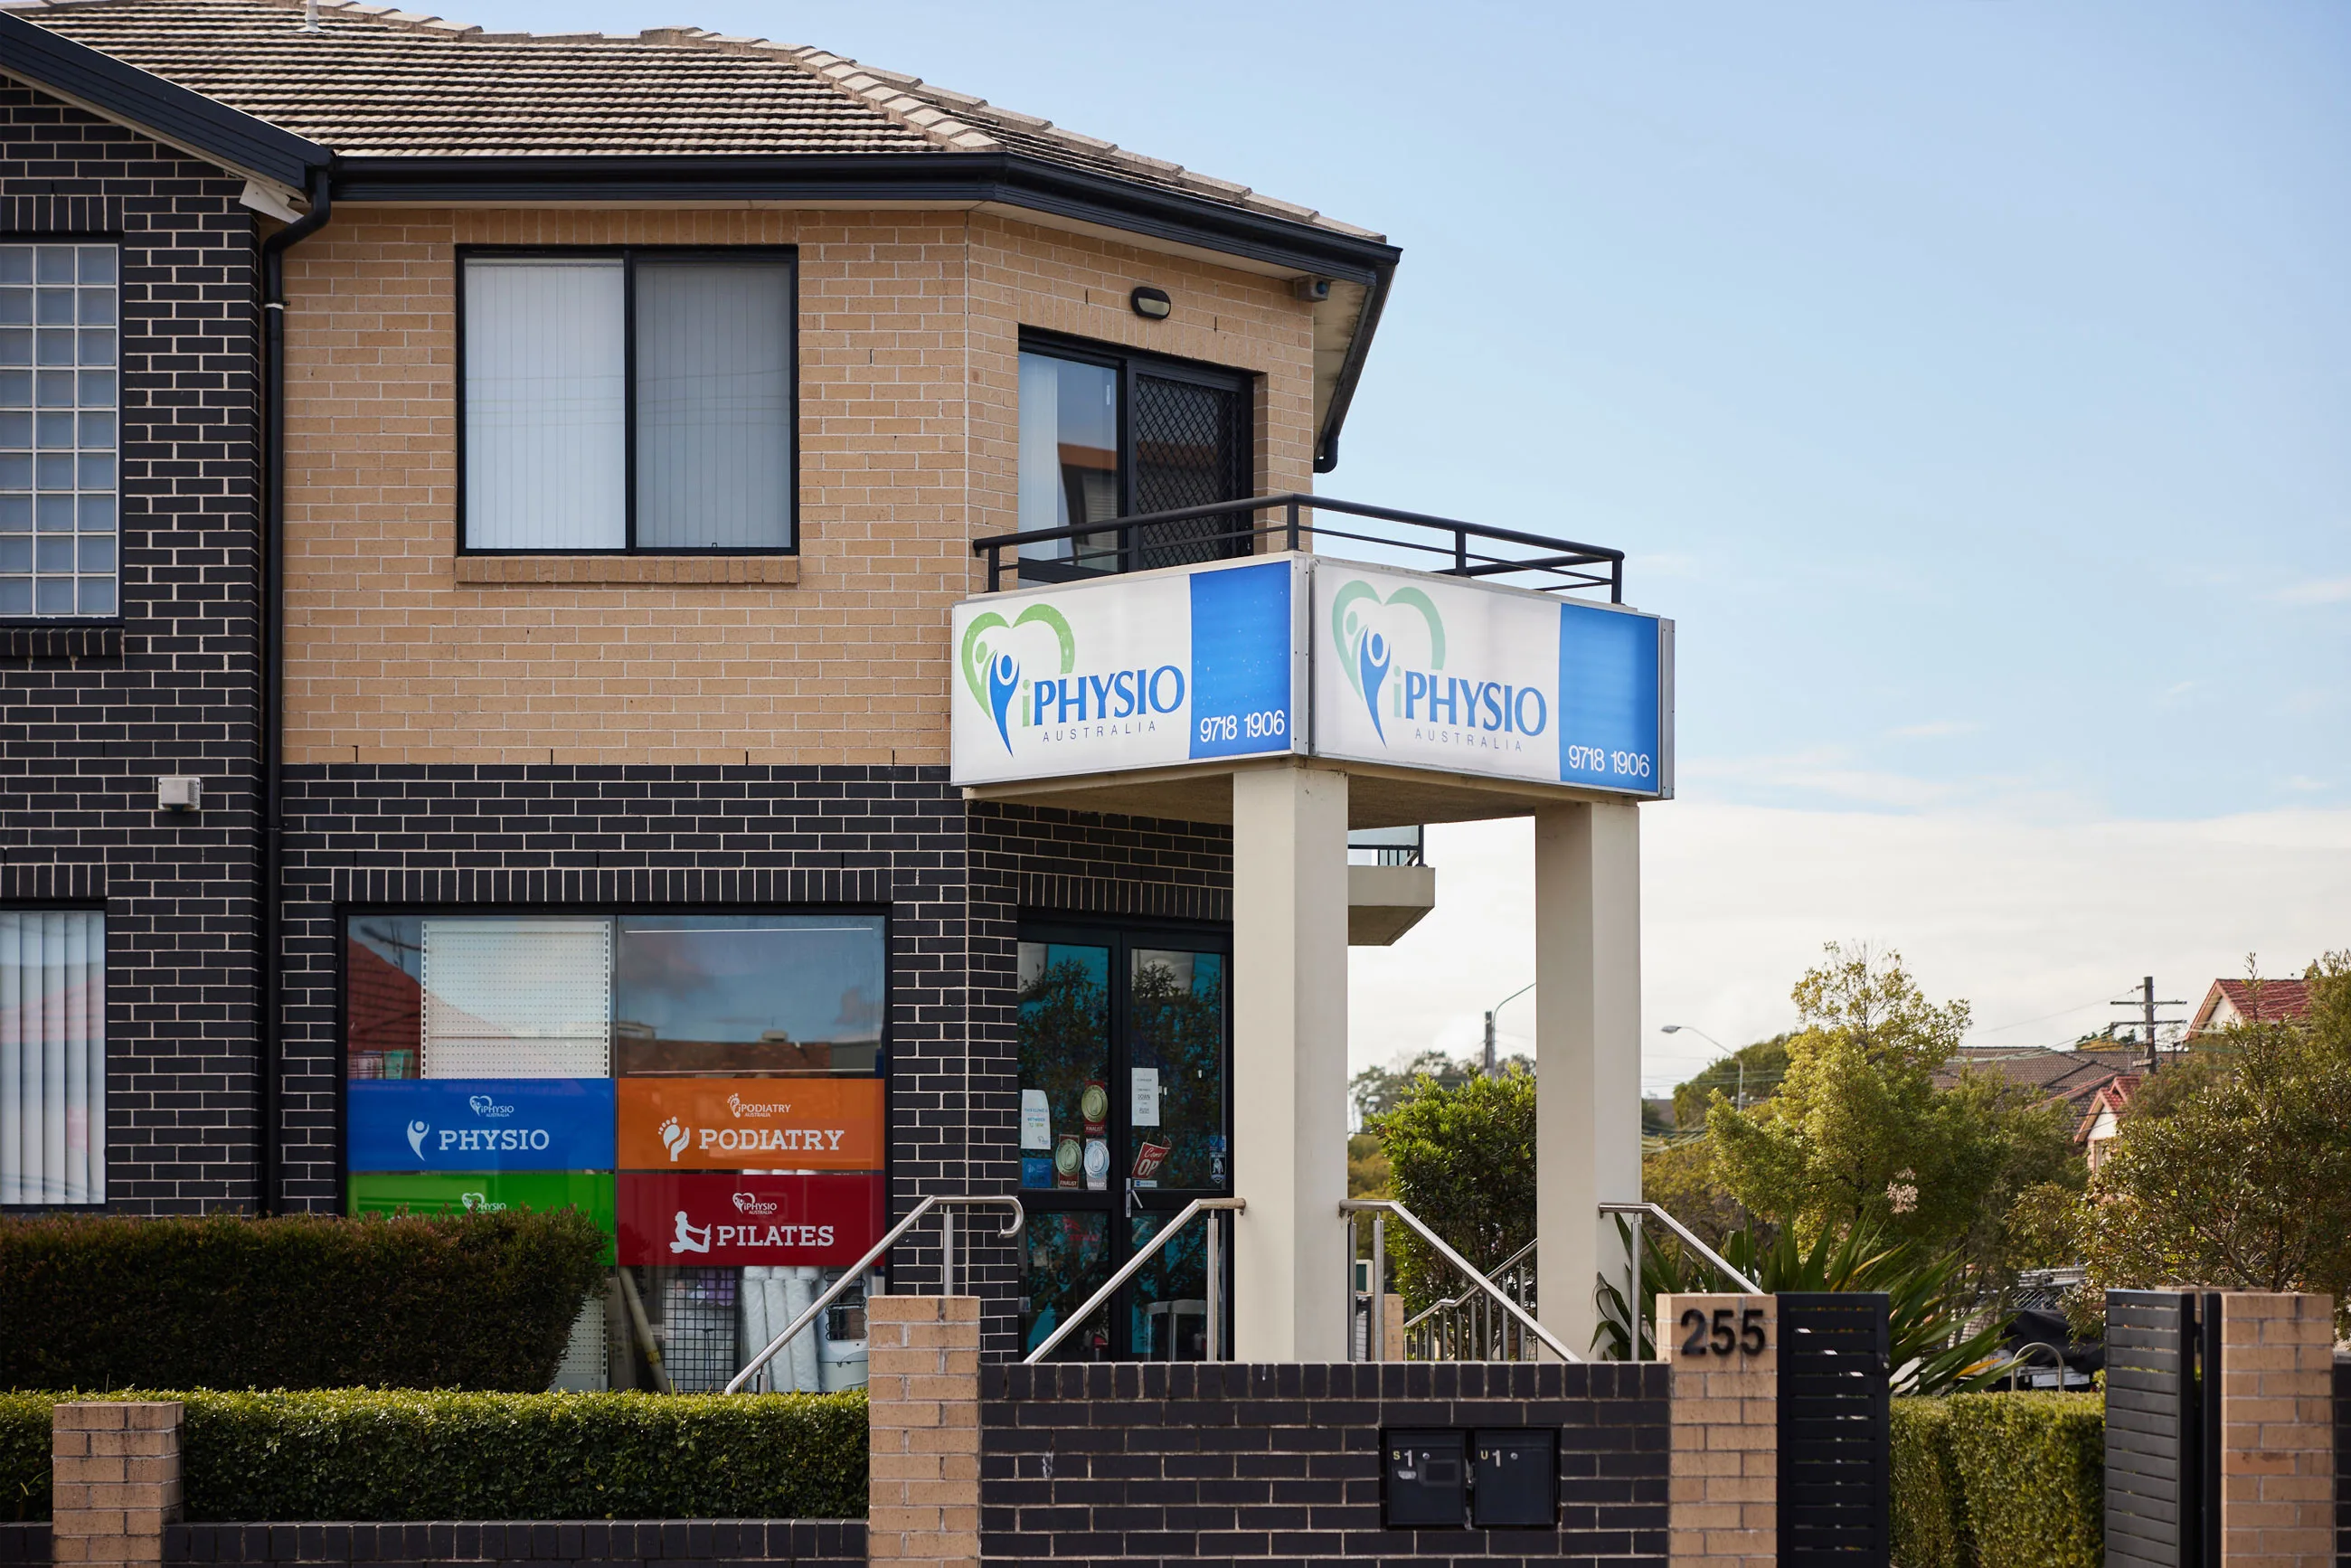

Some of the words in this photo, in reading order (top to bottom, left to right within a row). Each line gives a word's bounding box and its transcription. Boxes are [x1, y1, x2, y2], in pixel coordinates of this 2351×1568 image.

[1022, 665, 1185, 727] iPHYSIO
[1393, 665, 1547, 736] iPHYSIO
[1043, 721, 1156, 742] AUSTRALIA
[1200, 715, 1238, 742] 9718
[1243, 709, 1285, 738] 1906
[1415, 728, 1522, 752] AUSTRALIA
[1568, 745, 1605, 772] 9718
[1610, 751, 1650, 778] 1906
[481, 1105, 515, 1113] iPHYSIO
[738, 1103, 791, 1113] iPODIATRY
[439, 1129, 550, 1150] PHYSIO
[699, 1129, 845, 1150] PODIATRY
[476, 1202, 506, 1211] PHYSIO
[743, 1203, 778, 1211] iPHYSIO
[717, 1225, 835, 1247] PILATES
[1680, 1308, 1767, 1356] 255
